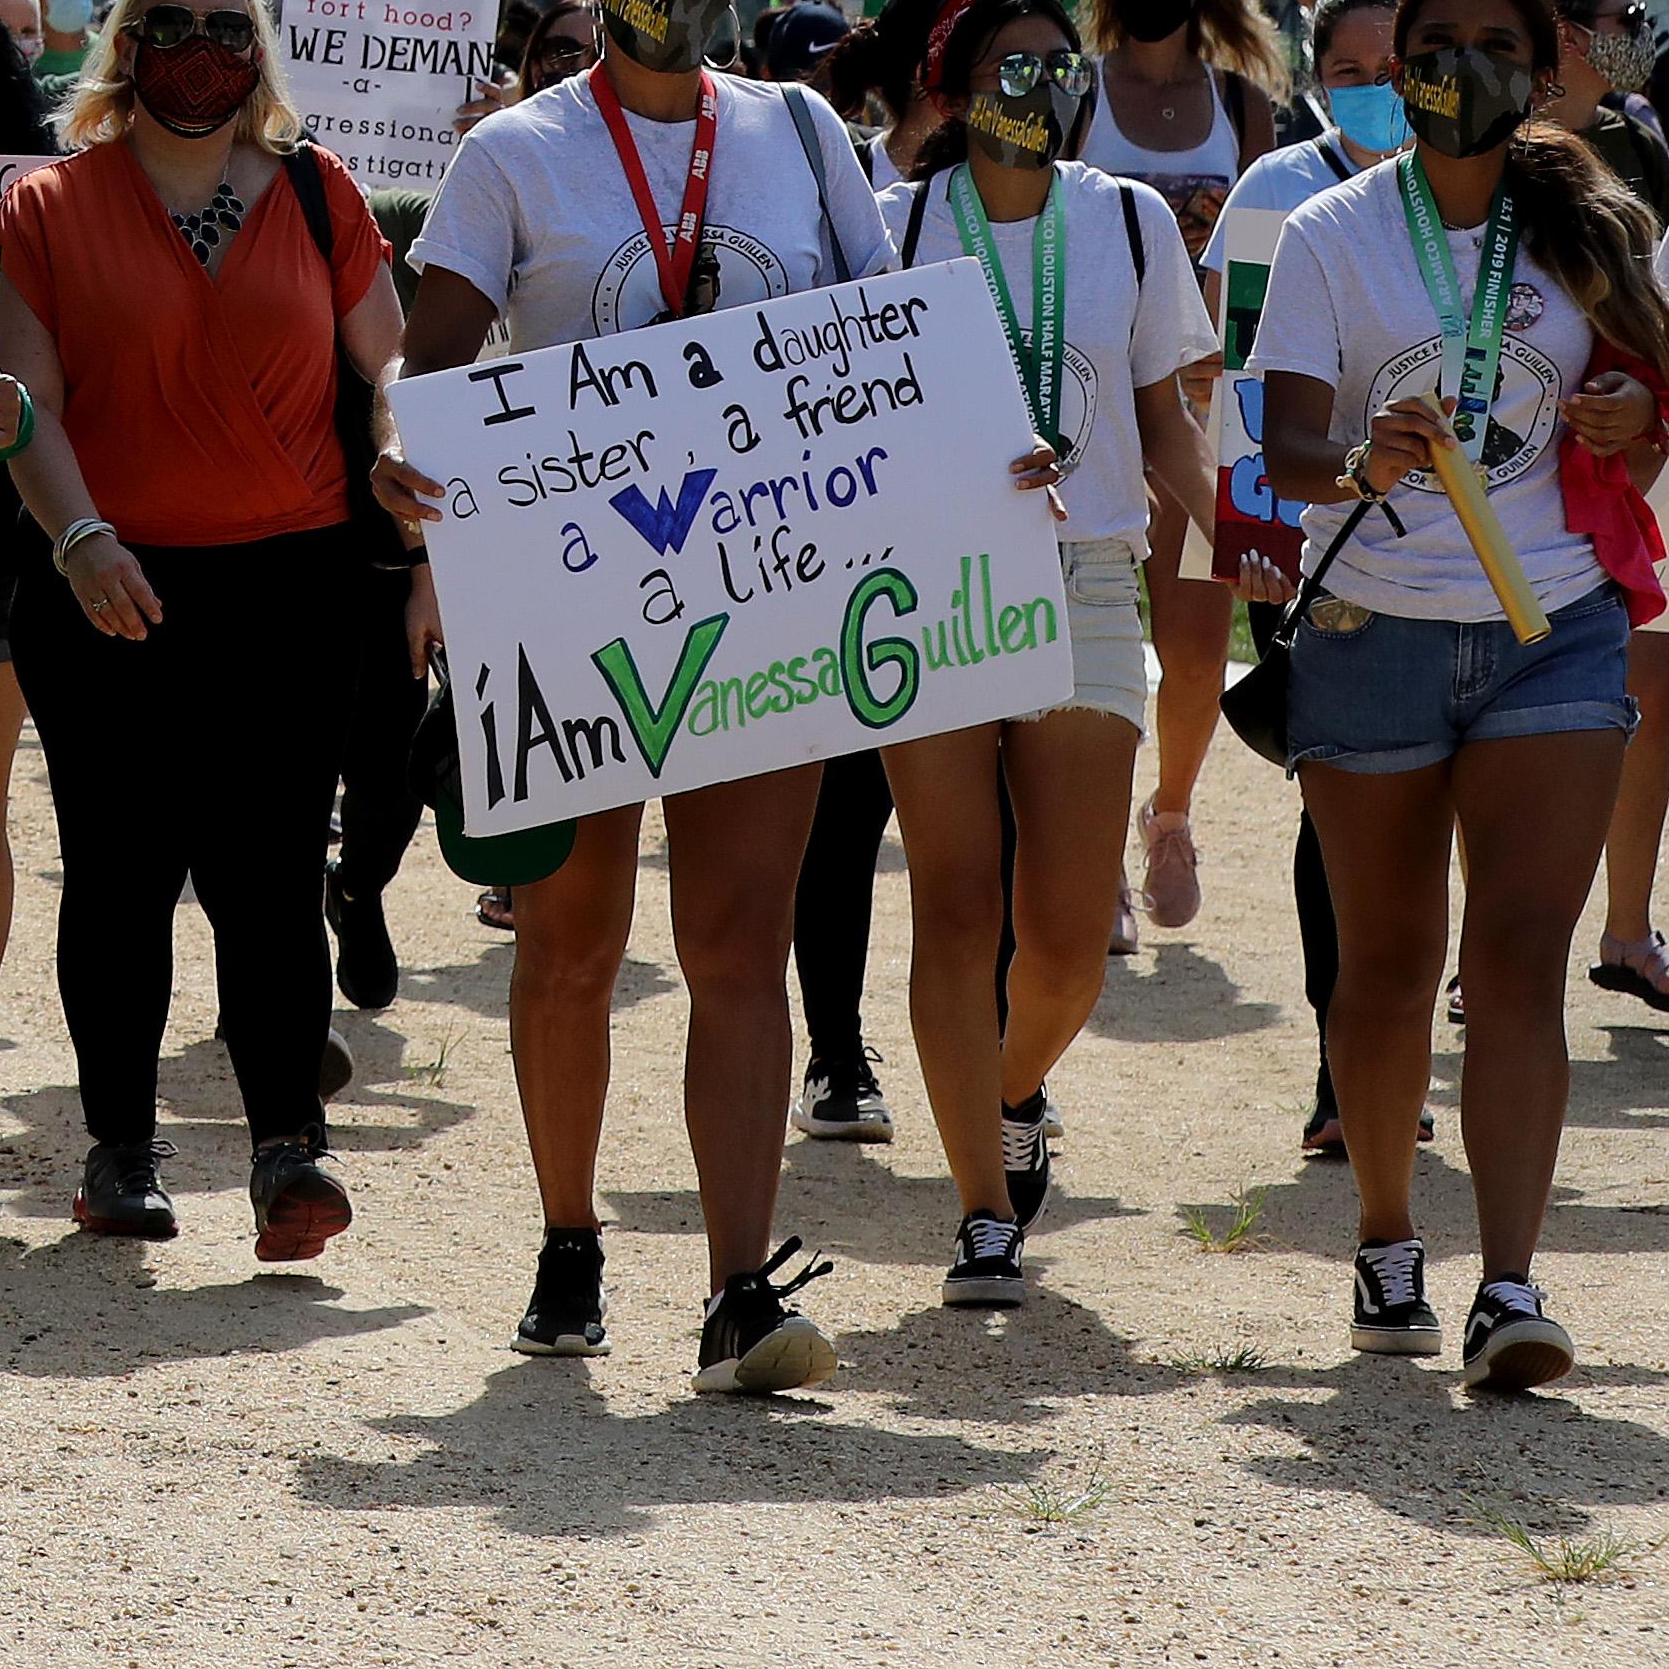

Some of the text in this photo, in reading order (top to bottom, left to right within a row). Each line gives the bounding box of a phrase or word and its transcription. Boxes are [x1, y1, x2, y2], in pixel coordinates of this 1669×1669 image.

[384, 4, 472, 32] hood?
[289, 25, 346, 65] WE
[305, 114, 462, 145] gressiona
[691, 150, 708, 179] ABB
[679, 211, 697, 243] ABB
[615, 236, 774, 271] JUSTICE GUILLEN
[1494, 235, 1508, 268] 2019
[1044, 245, 1056, 317] HOUSTON
[1479, 271, 1502, 339] FINISHER
[469, 286, 928, 426] I Am a daughter
[1041, 319, 1056, 358] HALF
[1387, 344, 1431, 379] JUSTICE
[1515, 344, 1557, 384] GUILLEN
[447, 478, 481, 522] a
[723, 405, 761, 454] a
[784, 353, 923, 441] friend
[1496, 444, 1537, 482] GUILLEN
[562, 446, 887, 573] a Warrior
[642, 568, 684, 626] a
